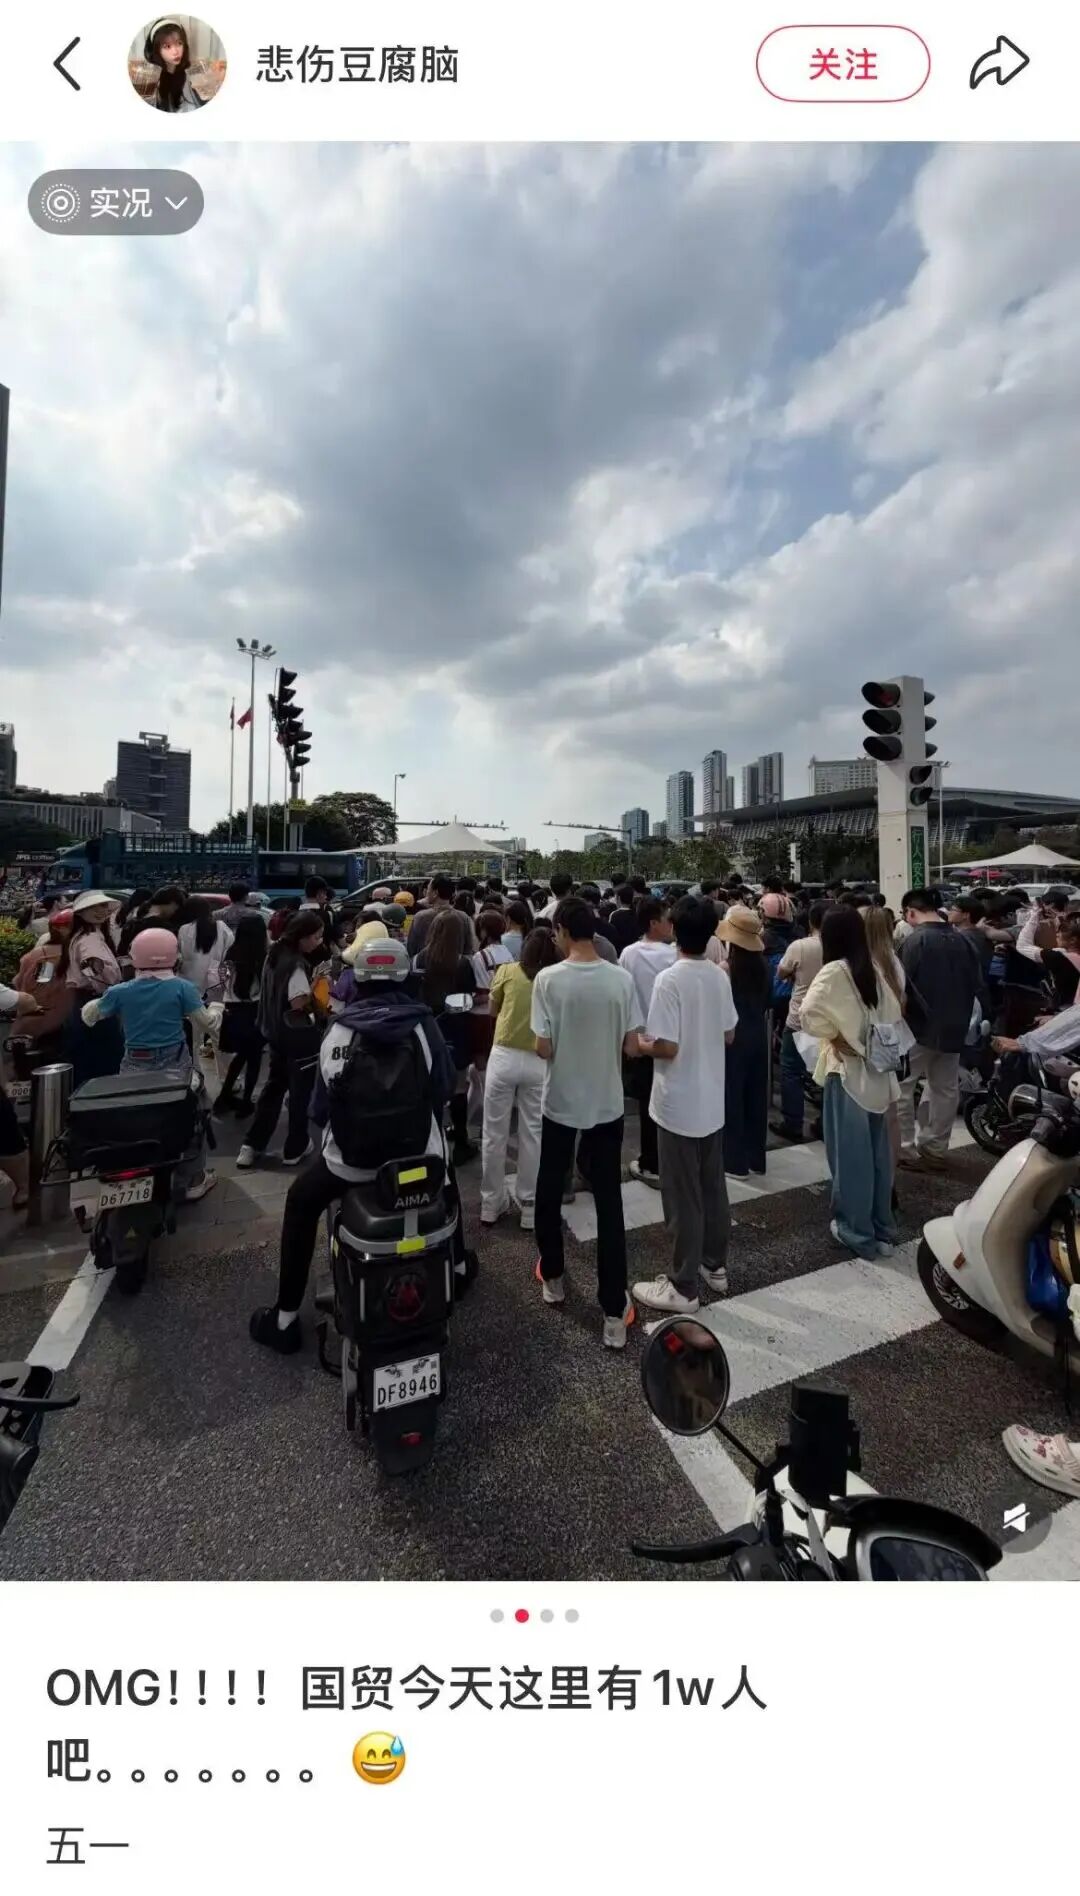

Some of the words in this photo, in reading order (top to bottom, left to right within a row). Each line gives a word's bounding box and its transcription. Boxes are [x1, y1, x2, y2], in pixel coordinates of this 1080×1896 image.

[100, 1187, 151, 1207] D67718
[394, 1192, 431, 1209] AIMA
[377, 1373, 438, 1406] DF8946
